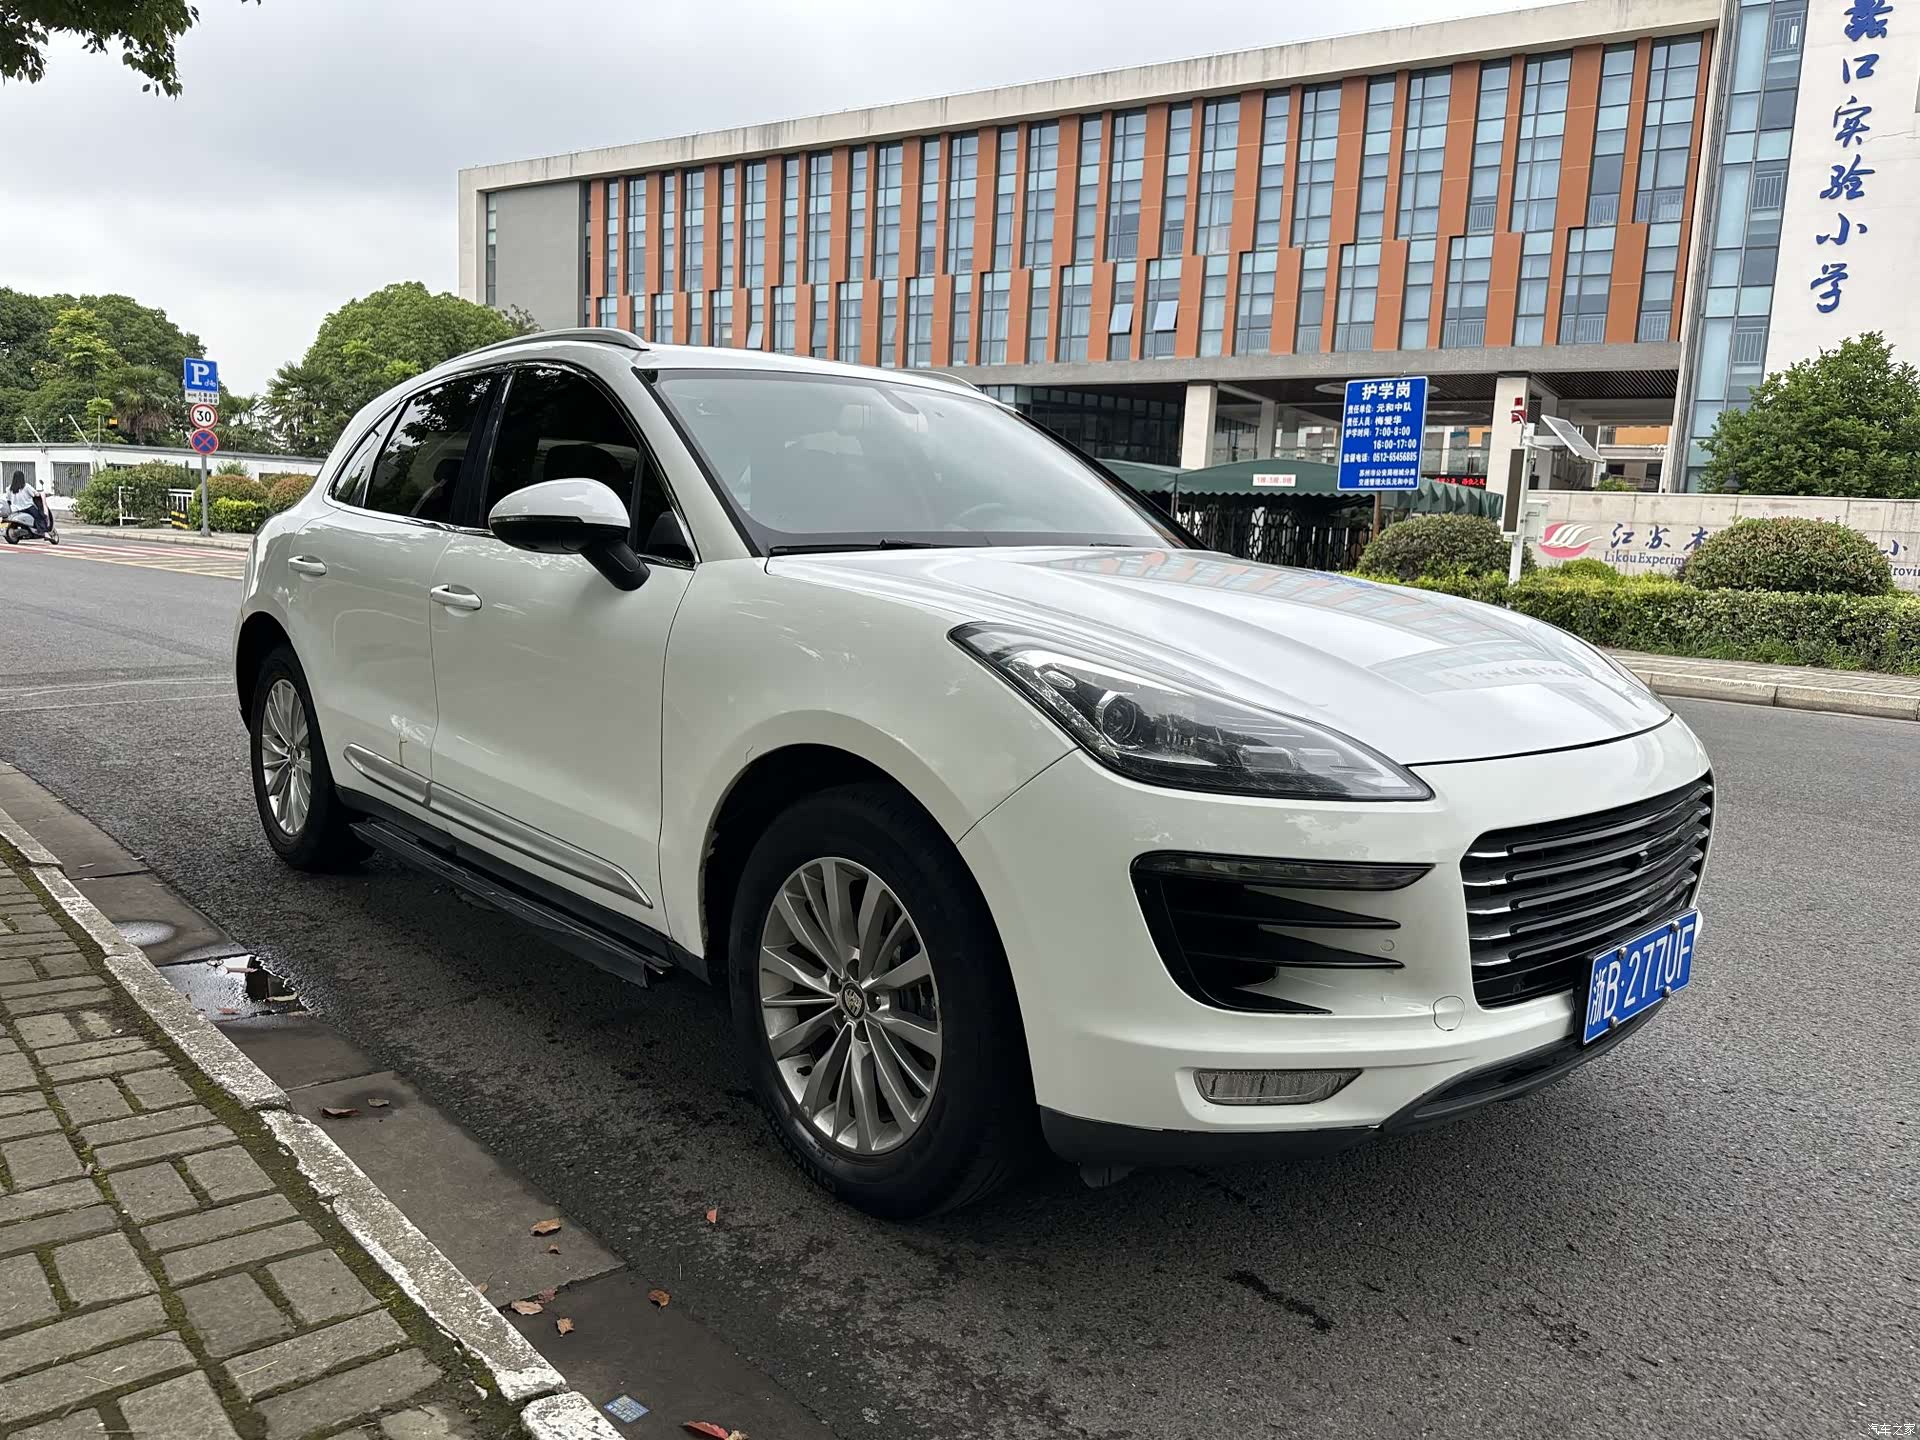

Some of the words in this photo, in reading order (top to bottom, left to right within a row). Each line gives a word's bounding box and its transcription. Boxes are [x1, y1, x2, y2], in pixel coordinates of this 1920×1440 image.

[190, 362, 210, 386] P
[1361, 381, 1411, 400] 护学岗
[1376, 402, 1412, 413] 元和中队
[196, 410, 212, 423] 30
[1374, 426, 1411, 438] 7:00-8:00
[1373, 439, 1417, 450] 16:00-17:00
[1604, 550, 1637, 563] Likou
